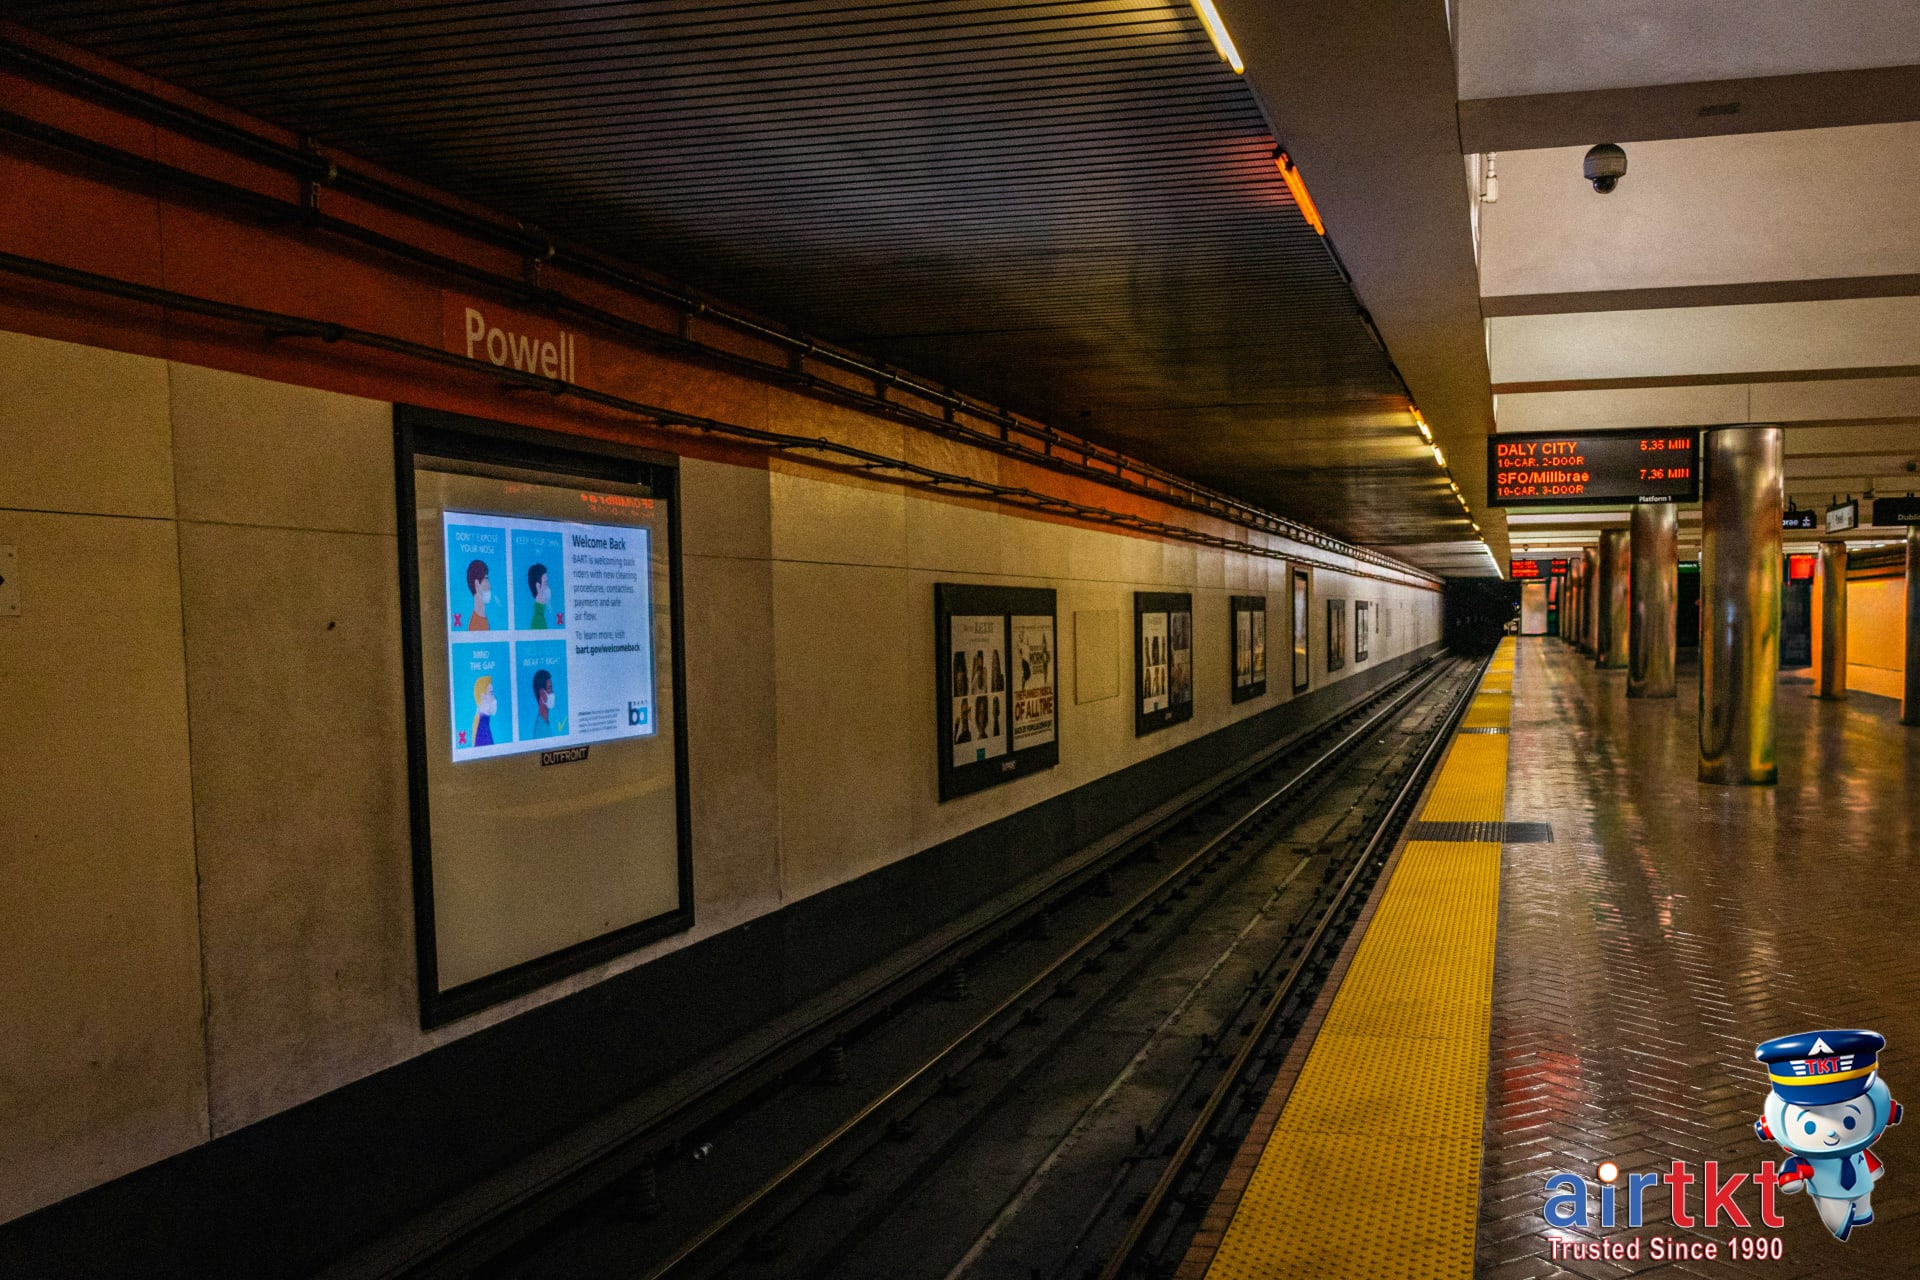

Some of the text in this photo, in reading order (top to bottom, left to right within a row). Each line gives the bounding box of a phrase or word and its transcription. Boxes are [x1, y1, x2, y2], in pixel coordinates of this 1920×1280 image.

[465, 307, 575, 385] Powell
[1497, 441, 1577, 457] DALY CITY
[1668, 438, 1690, 450] MIN
[1542, 456, 1584, 467] 2-DOOR
[1497, 471, 1590, 485] SFO/Millbrae
[1667, 468, 1689, 479] MIN
[1542, 485, 1584, 495] 3-DOOR
[1897, 513, 1920, 521] Dubli
[572, 534, 626, 550] Welcome Back
[572, 554, 587, 564] BART
[594, 556, 622, 568] welcoming
[623, 558, 636, 566] back
[573, 569, 637, 582] riders with new cleaning
[574, 599, 598, 608] payment
[599, 598, 609, 607] and
[576, 631, 582, 640] To
[584, 630, 597, 640] learn
[615, 630, 625, 639] visit
[575, 642, 640, 656] bart.gov/welcomeback
[469, 661, 495, 671] THE GAP
[1015, 697, 1053, 721] OF ALL TIME
[543, 748, 587, 765] OUTFRONT
